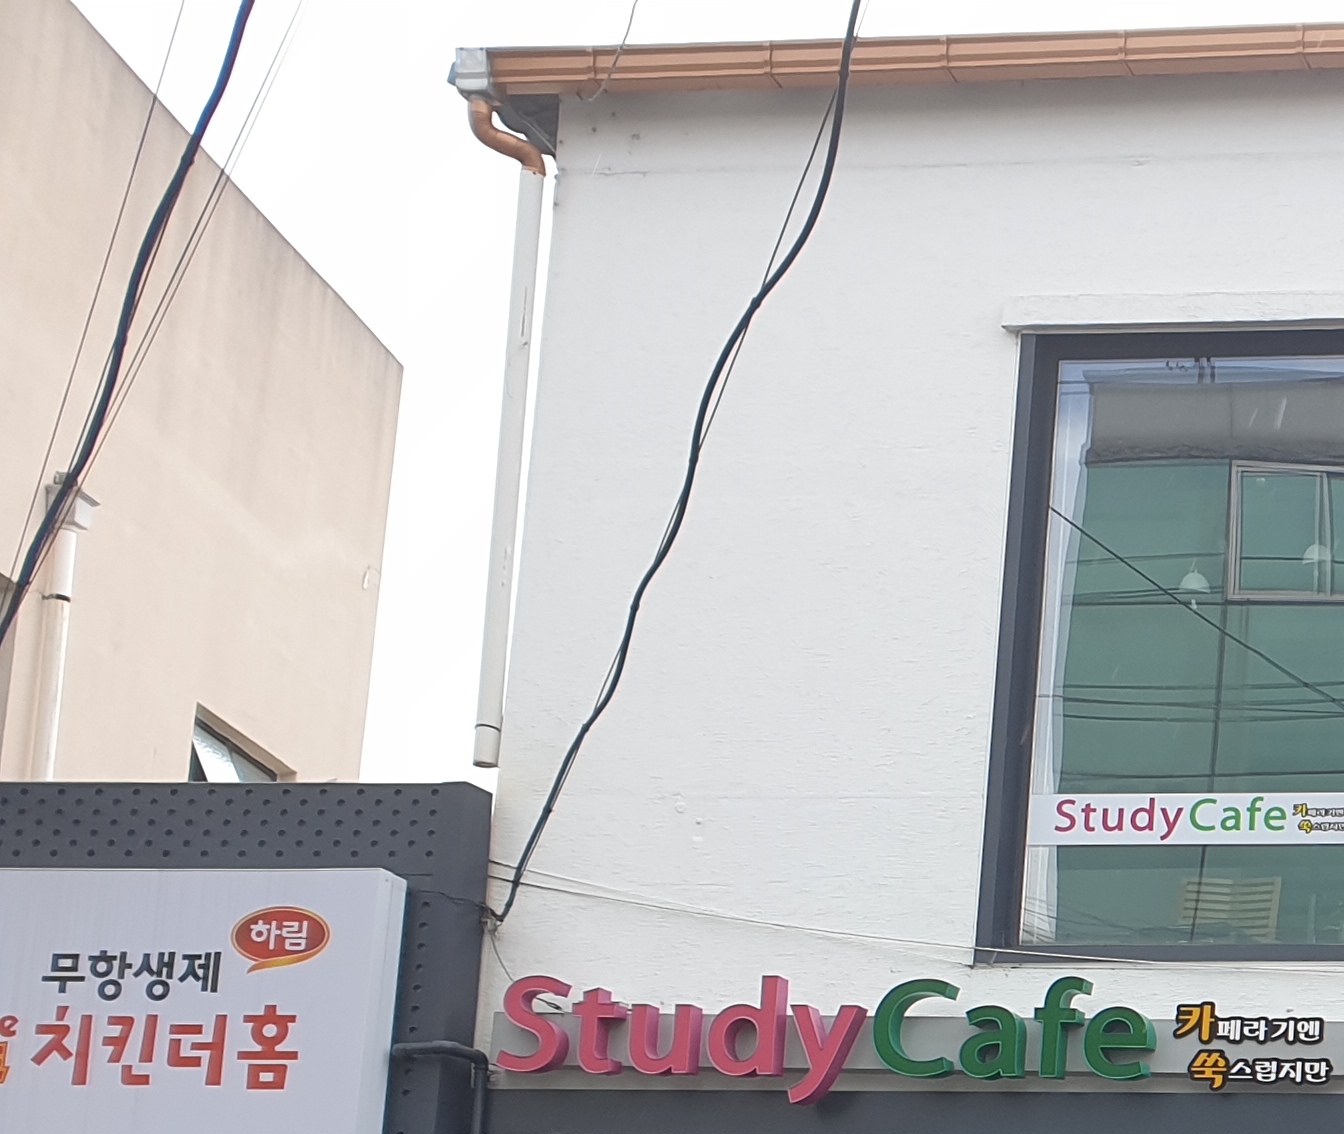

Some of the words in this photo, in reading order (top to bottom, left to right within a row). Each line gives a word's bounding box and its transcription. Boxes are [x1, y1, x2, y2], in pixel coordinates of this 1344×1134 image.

[250, 920, 308, 950] 하림
[42, 950, 222, 1001] 무항생제
[31, 1004, 299, 1090] 치킨더홈
[1188, 1049, 1333, 1091] 쑥스럽지만
